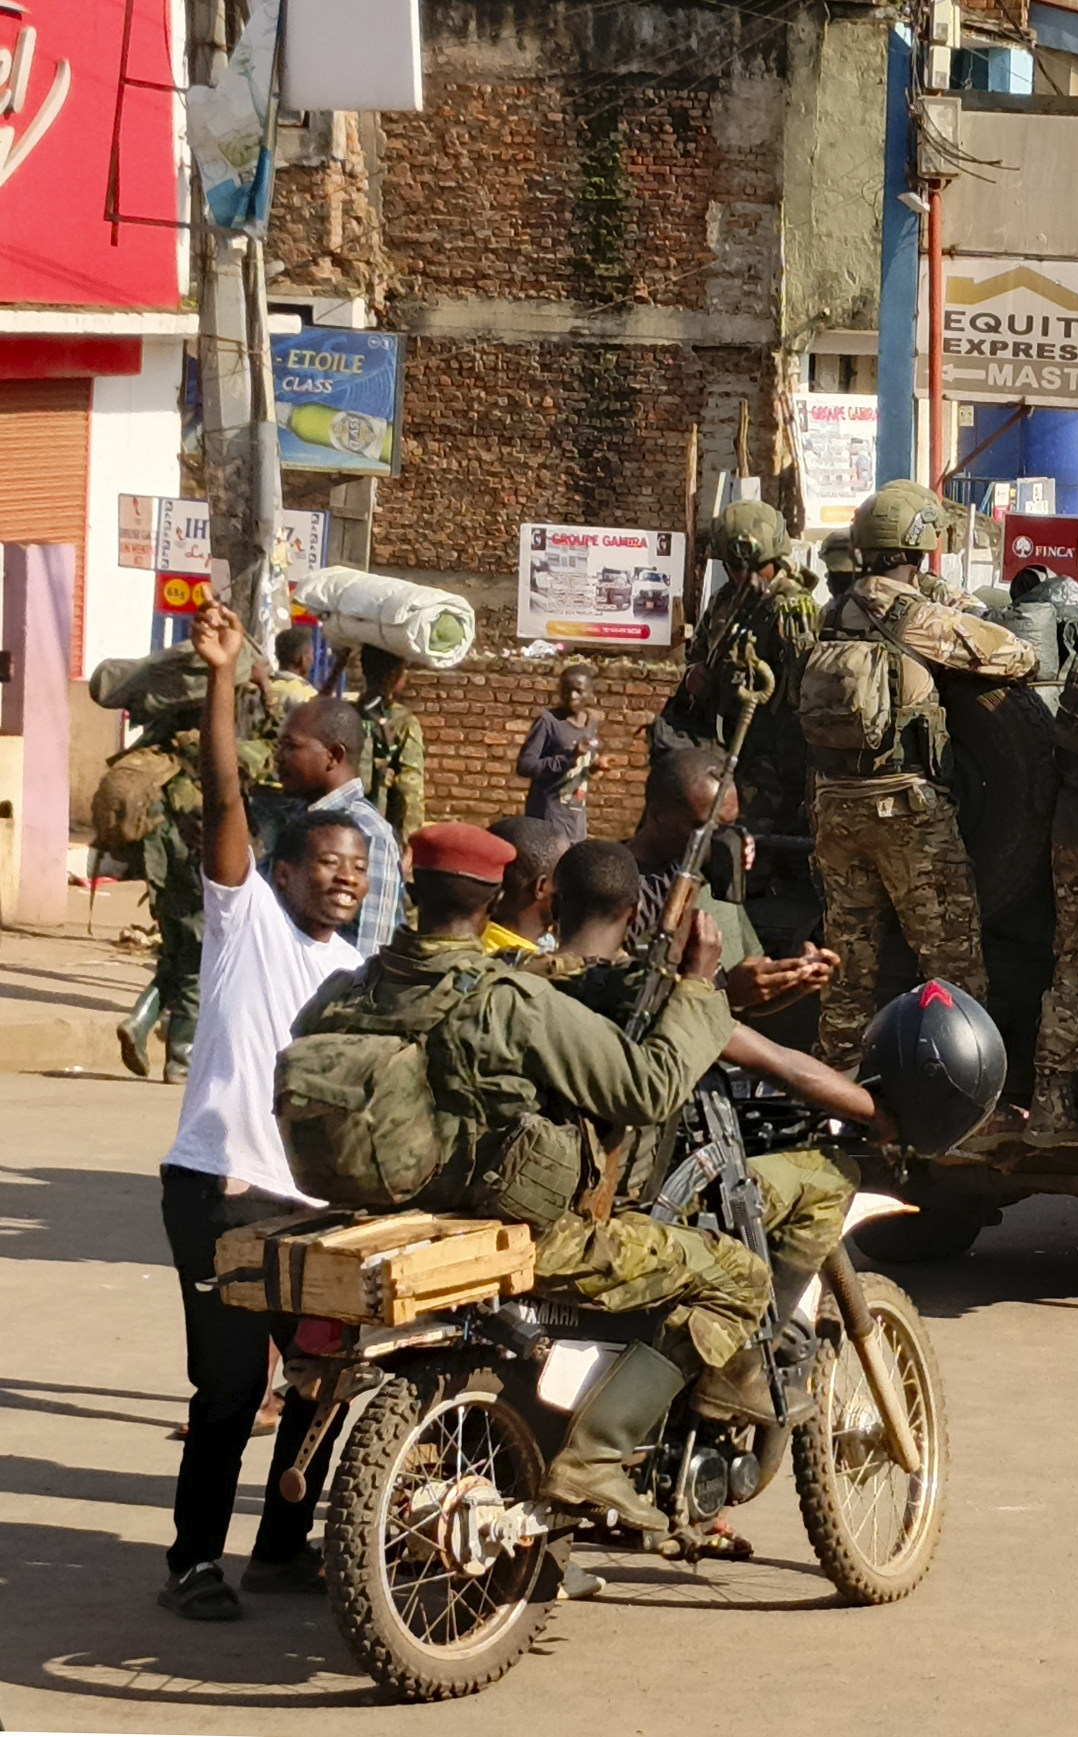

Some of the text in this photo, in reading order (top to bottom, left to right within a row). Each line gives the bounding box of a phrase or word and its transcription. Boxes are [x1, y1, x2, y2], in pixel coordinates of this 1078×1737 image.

[287, 349, 364, 374] ETOILE
[282, 376, 333, 393] CLASS
[551, 533, 599, 548] GROUPE
[1035, 545, 1073, 558] FINCA
[519, 1299, 579, 1326] YAMAHA
